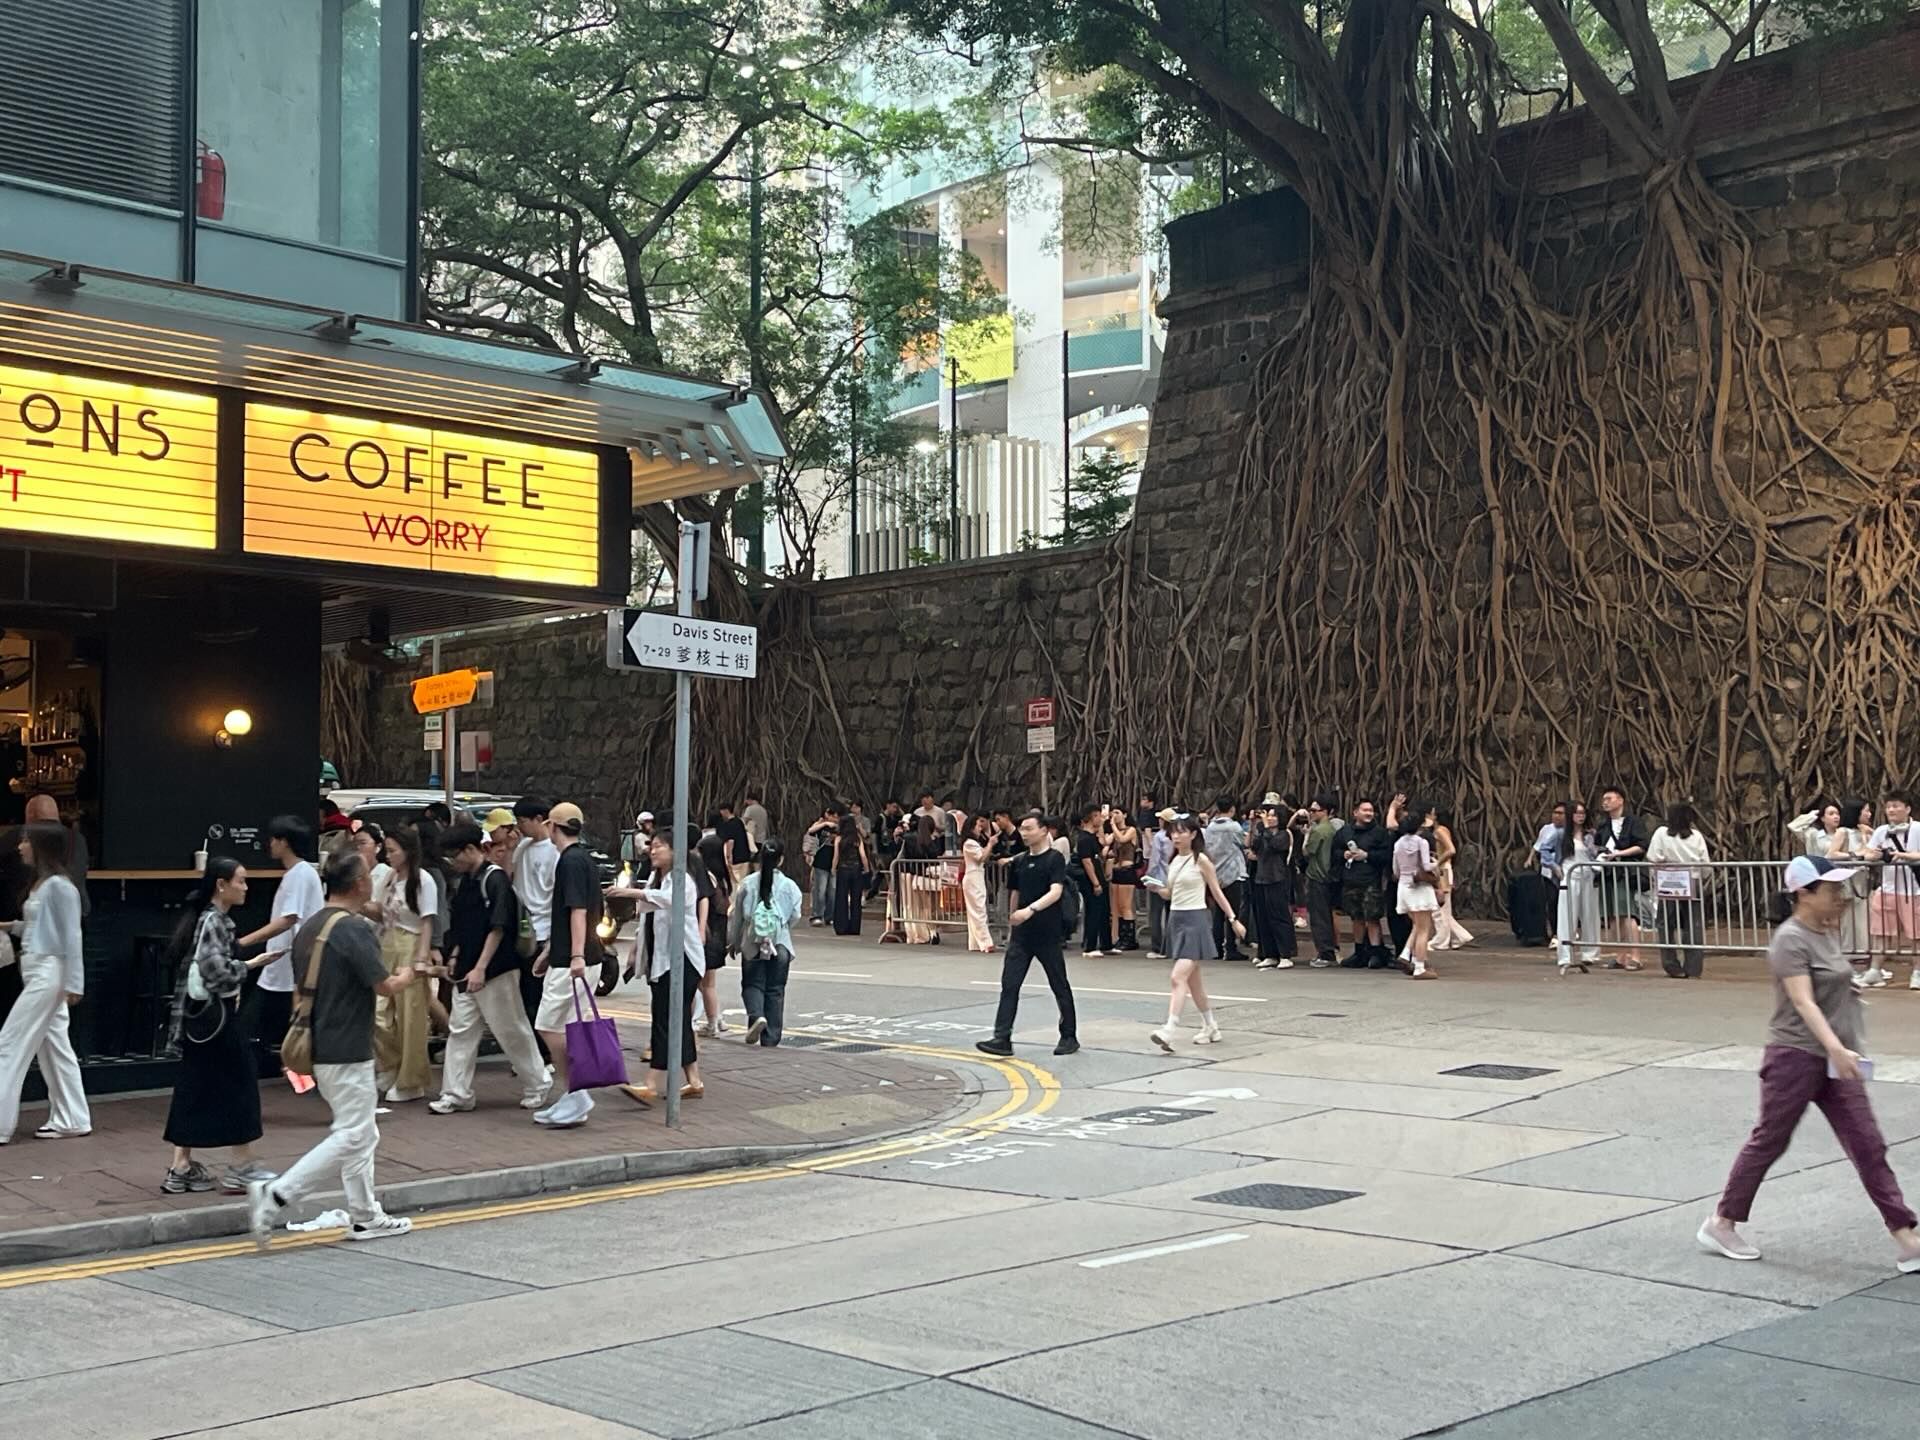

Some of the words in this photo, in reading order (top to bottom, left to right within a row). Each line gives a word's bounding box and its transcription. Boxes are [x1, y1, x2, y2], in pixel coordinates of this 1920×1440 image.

[290, 433, 544, 510] COFFEE
[362, 511, 489, 552] WORRY
[673, 623, 708, 640] Davis
[713, 628, 753, 646] Street
[910, 1141, 1056, 1169] LEFT
